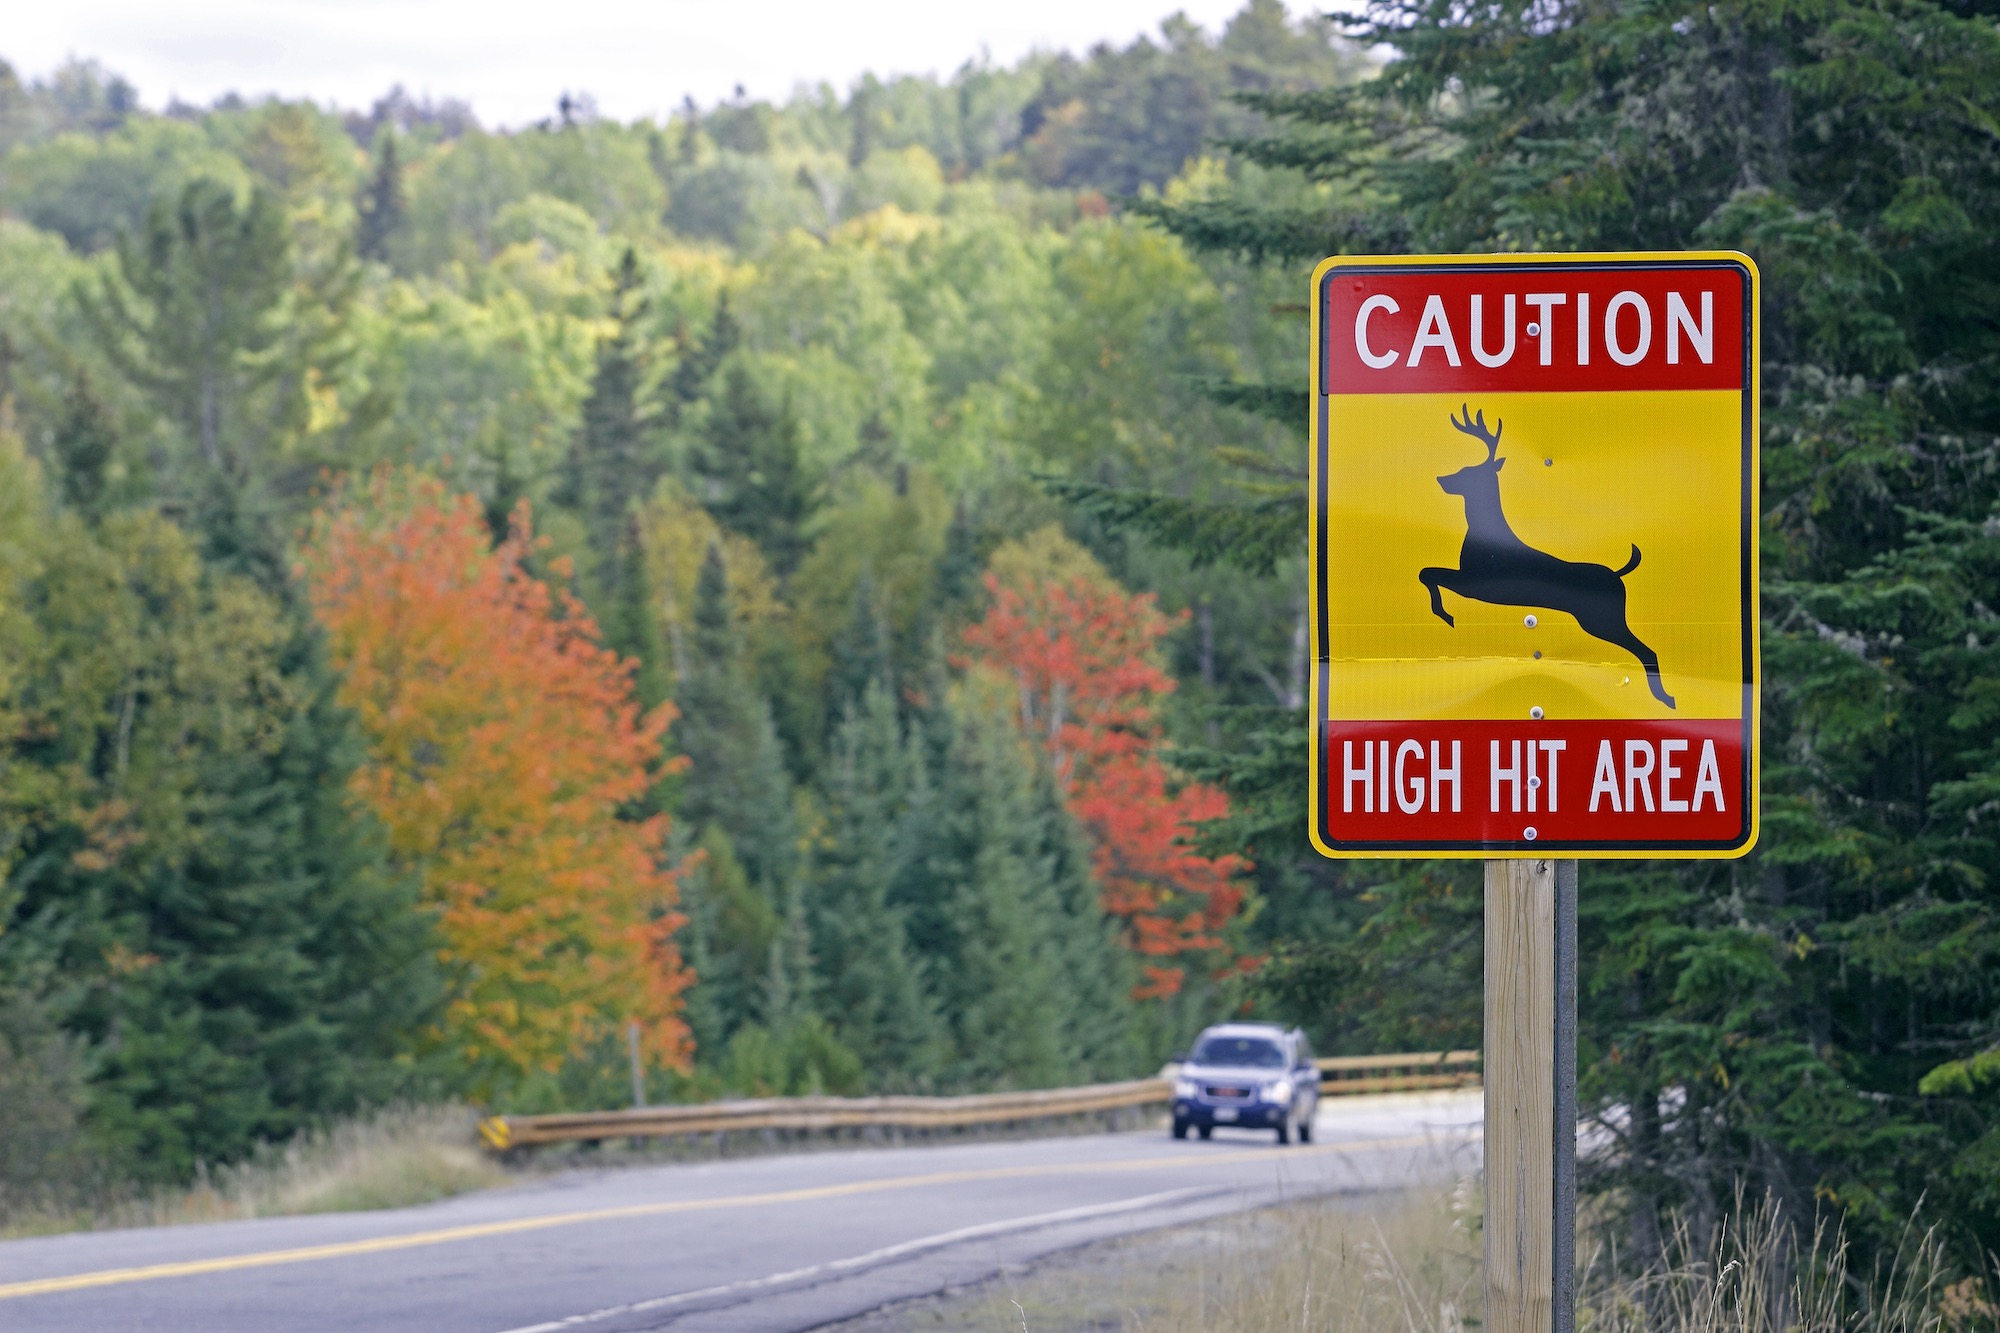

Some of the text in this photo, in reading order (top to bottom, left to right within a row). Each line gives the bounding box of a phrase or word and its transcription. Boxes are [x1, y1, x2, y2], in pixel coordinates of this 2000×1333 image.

[1354, 291, 1714, 370] CAUTION
[1343, 739, 1726, 814] HIGH HIT AREA
